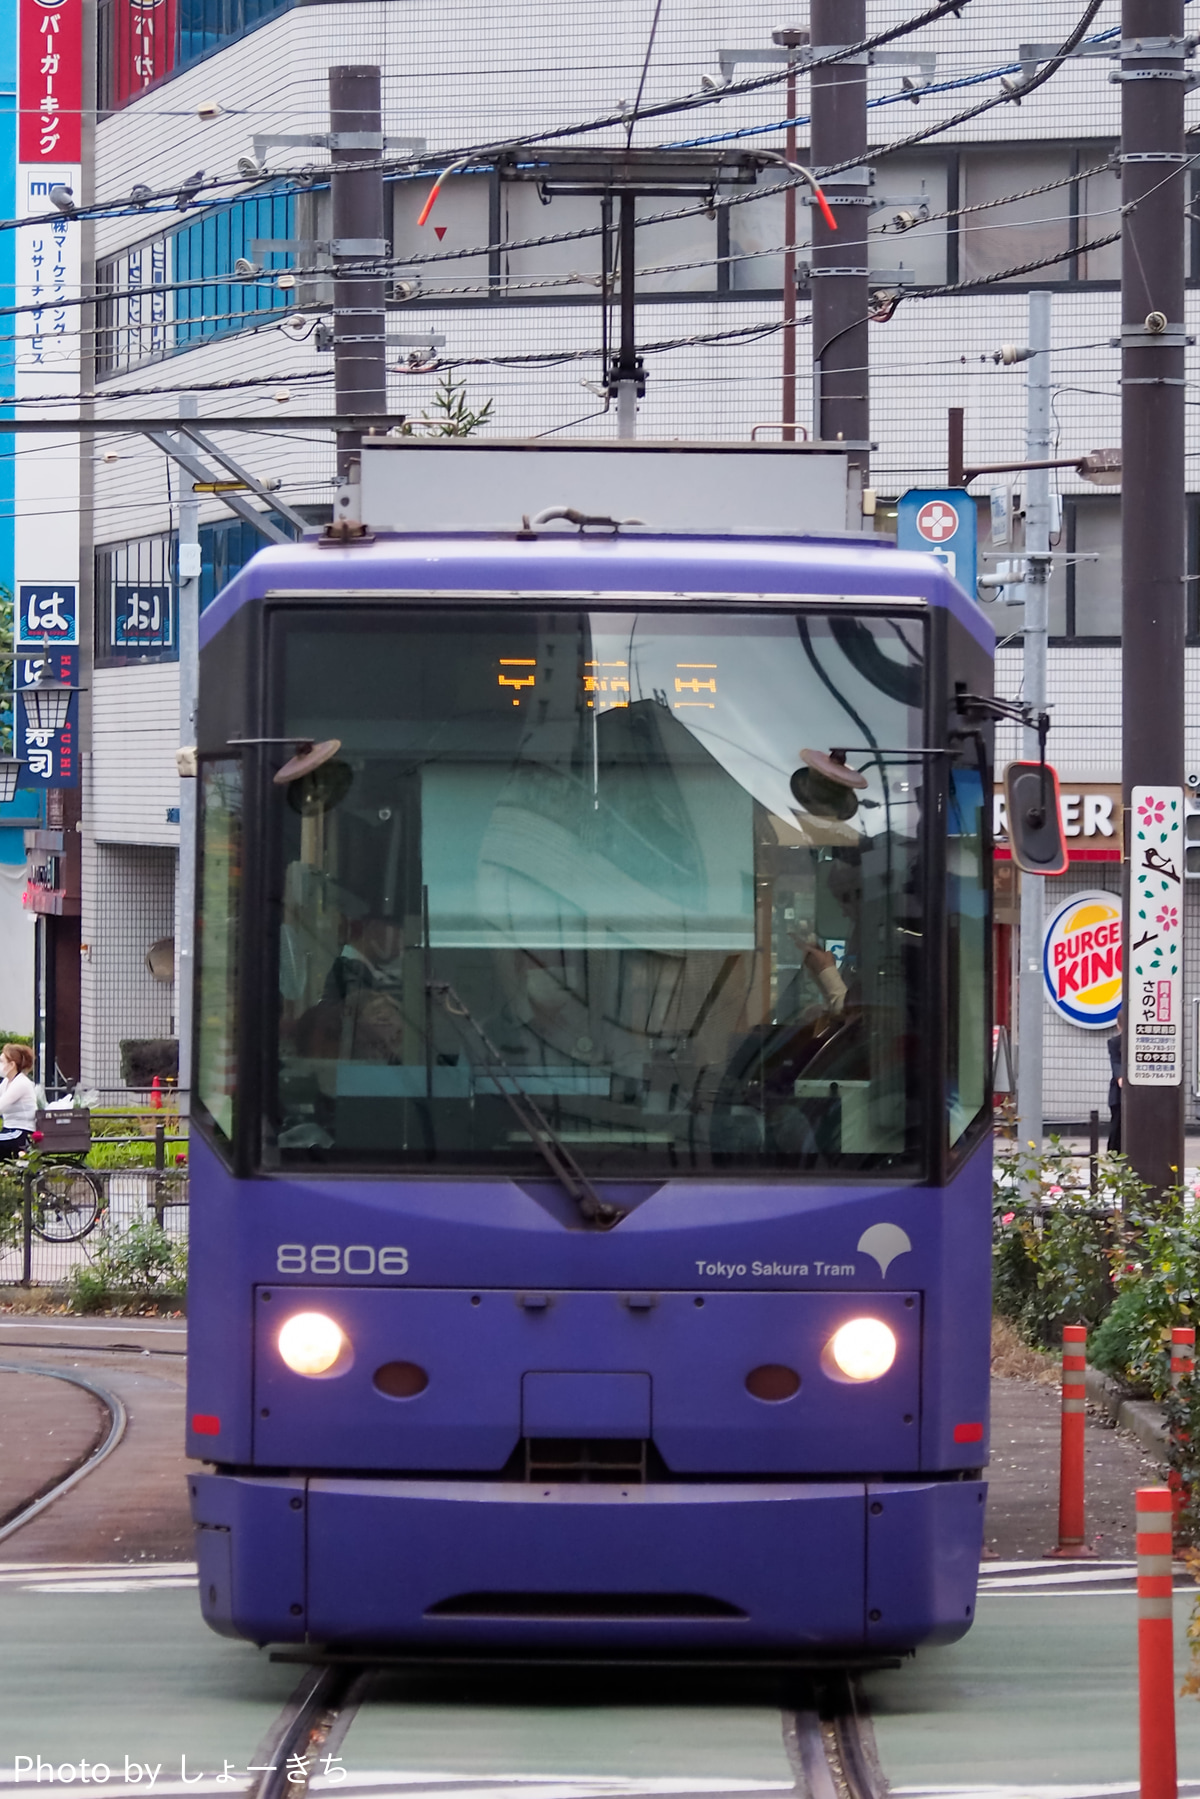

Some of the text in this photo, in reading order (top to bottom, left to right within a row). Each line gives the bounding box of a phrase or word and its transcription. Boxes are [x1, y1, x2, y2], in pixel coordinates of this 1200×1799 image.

[40, 14, 60, 154] バーガーキング
[28, 592, 69, 630] は
[1054, 922, 1123, 967] BURGE
[1142, 980, 1156, 1022] さのや
[277, 1244, 409, 1276] 8806
[696, 1261, 855, 1279] Tokyo Sakura Tram
